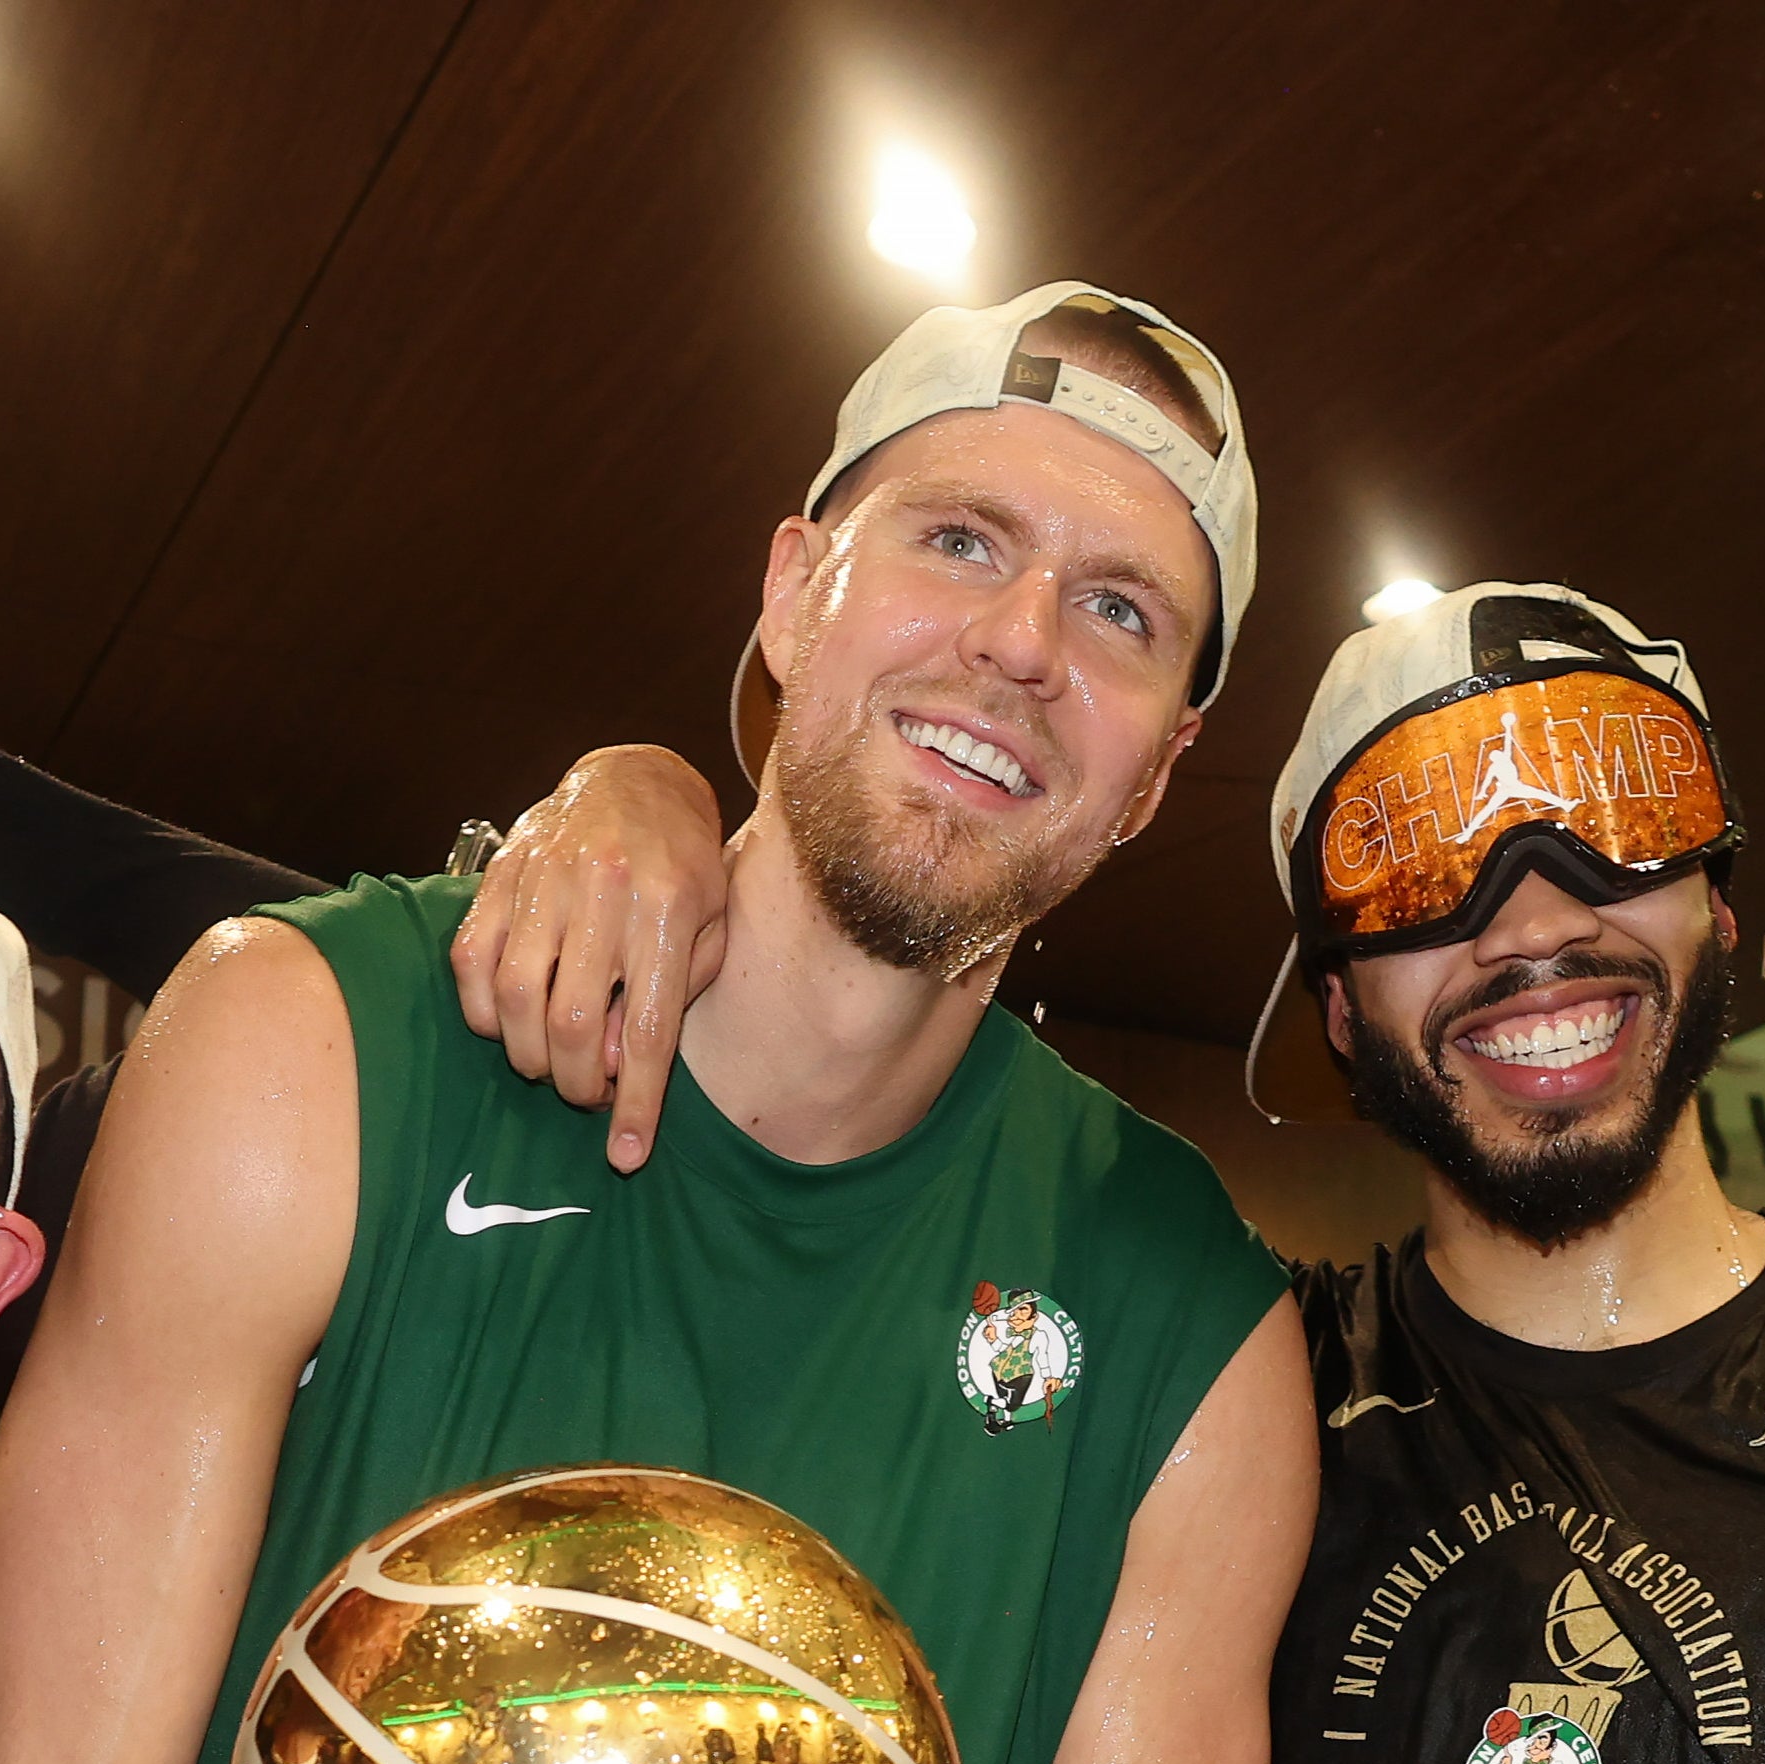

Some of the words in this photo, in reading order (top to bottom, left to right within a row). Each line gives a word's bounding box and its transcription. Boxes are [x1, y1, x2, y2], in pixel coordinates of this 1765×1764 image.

[1322, 712, 1699, 891] CHAMP
[955, 1311, 979, 1399] BOSTON
[1052, 1310, 1082, 1389] CELTICS
[1333, 1527, 1464, 1698] NATIONAL
[1606, 1542, 1754, 1748] ASSOCIATION
